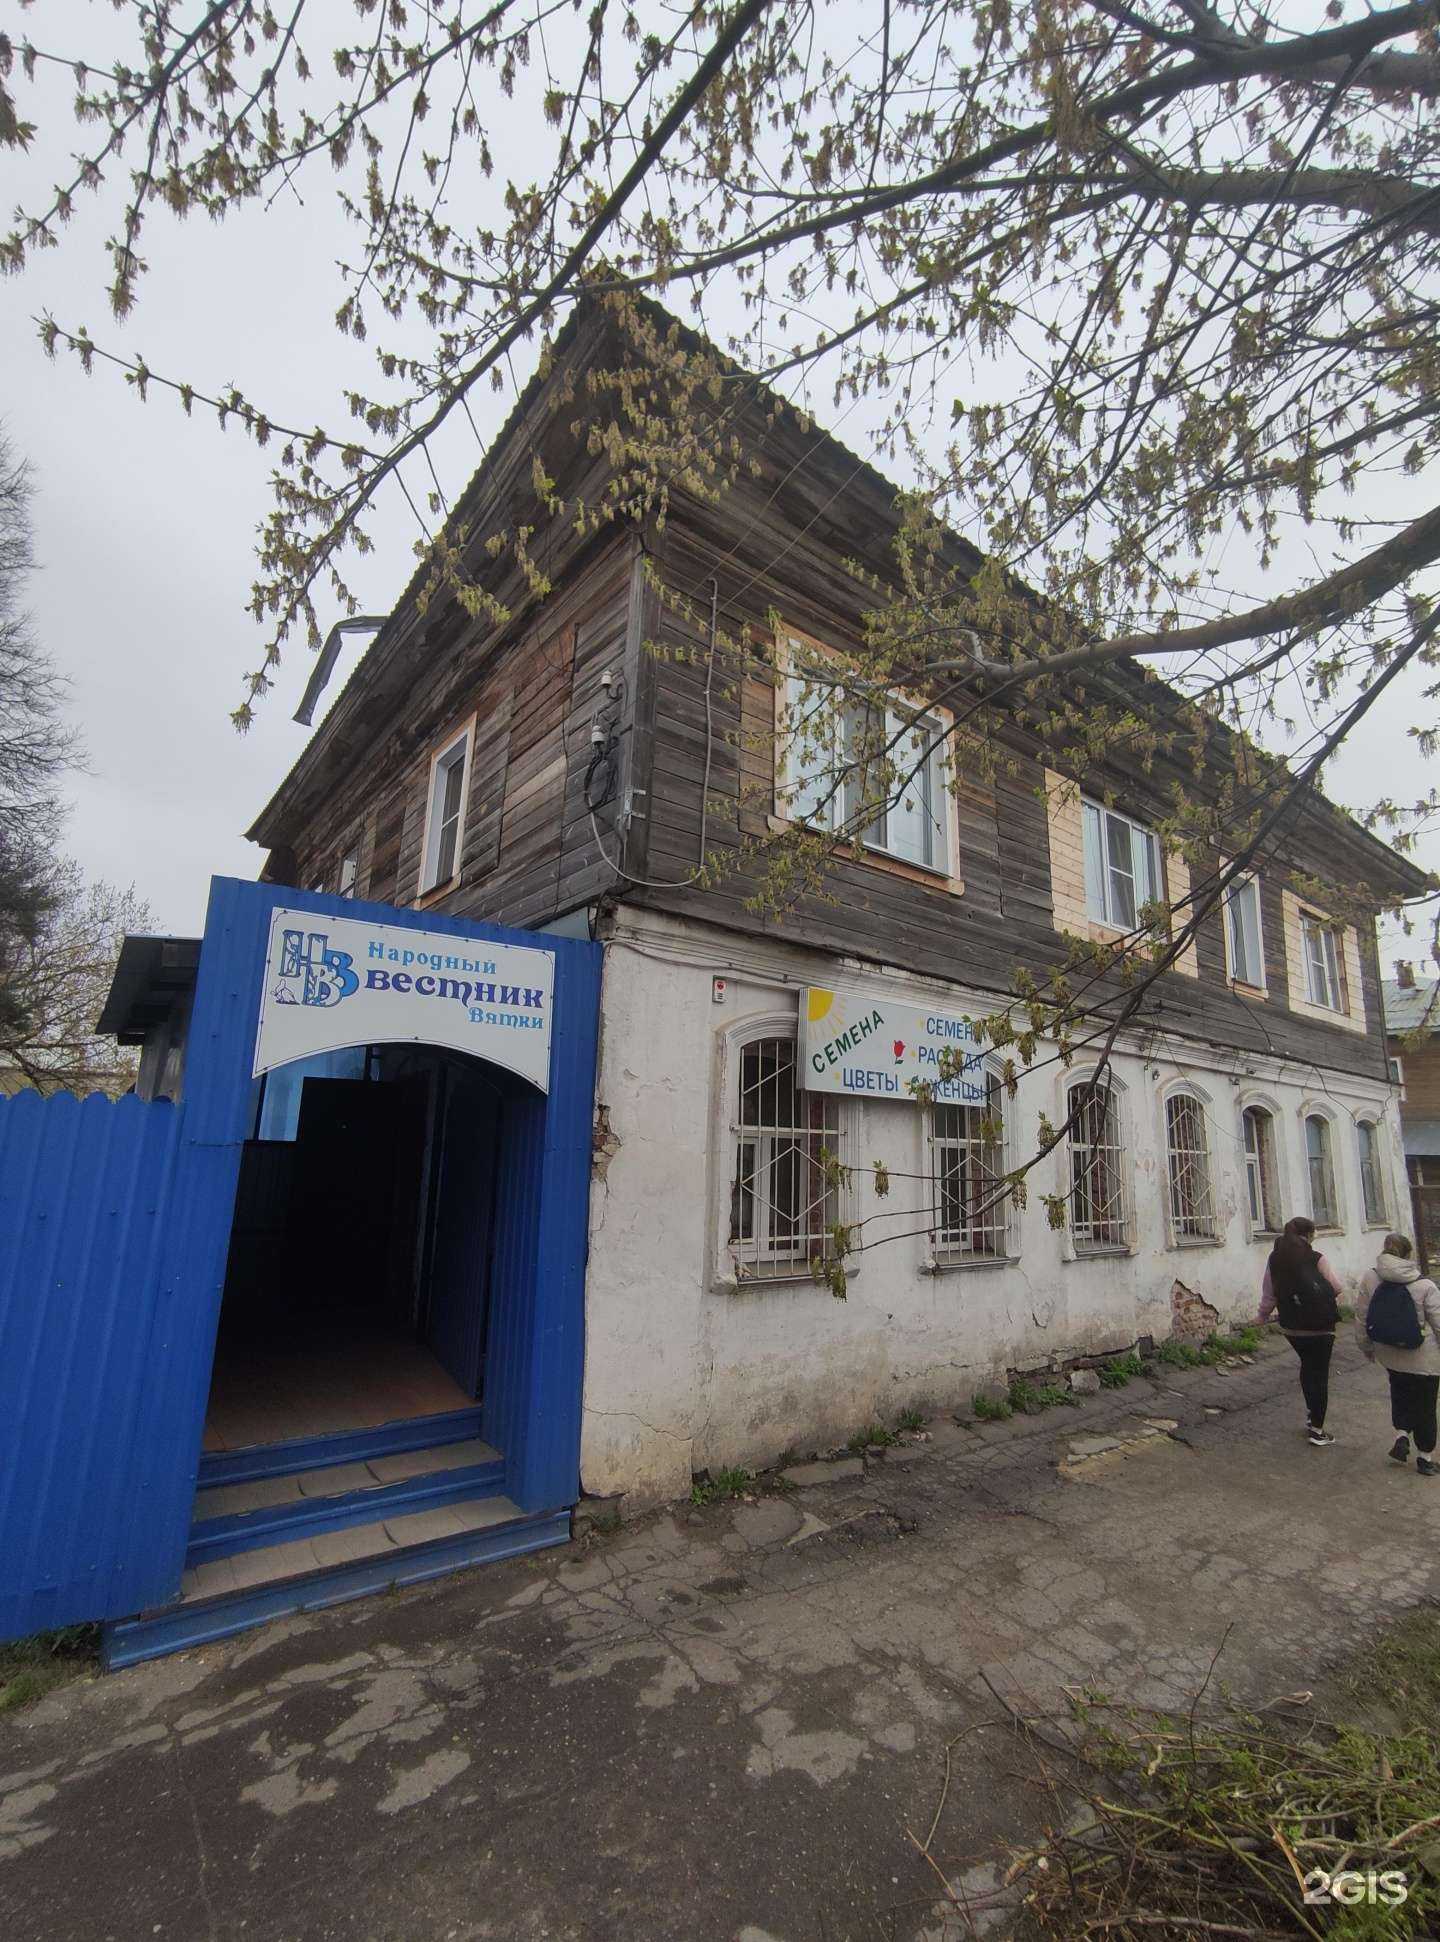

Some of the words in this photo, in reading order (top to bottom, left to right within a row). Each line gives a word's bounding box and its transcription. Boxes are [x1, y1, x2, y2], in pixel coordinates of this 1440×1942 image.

[368, 941, 497, 975] Народный
[365, 969, 545, 1008] вестник
[468, 1006, 544, 1030] Вятки
[926, 1017, 983, 1043] СЕМЕН
[812, 1009, 885, 1074] СЕМЕНА
[918, 1046, 983, 1072] РАСДА
[842, 1067, 899, 1092] ЦВЕТЫ
[911, 1076, 984, 1102] ЖЕНЦЫ
